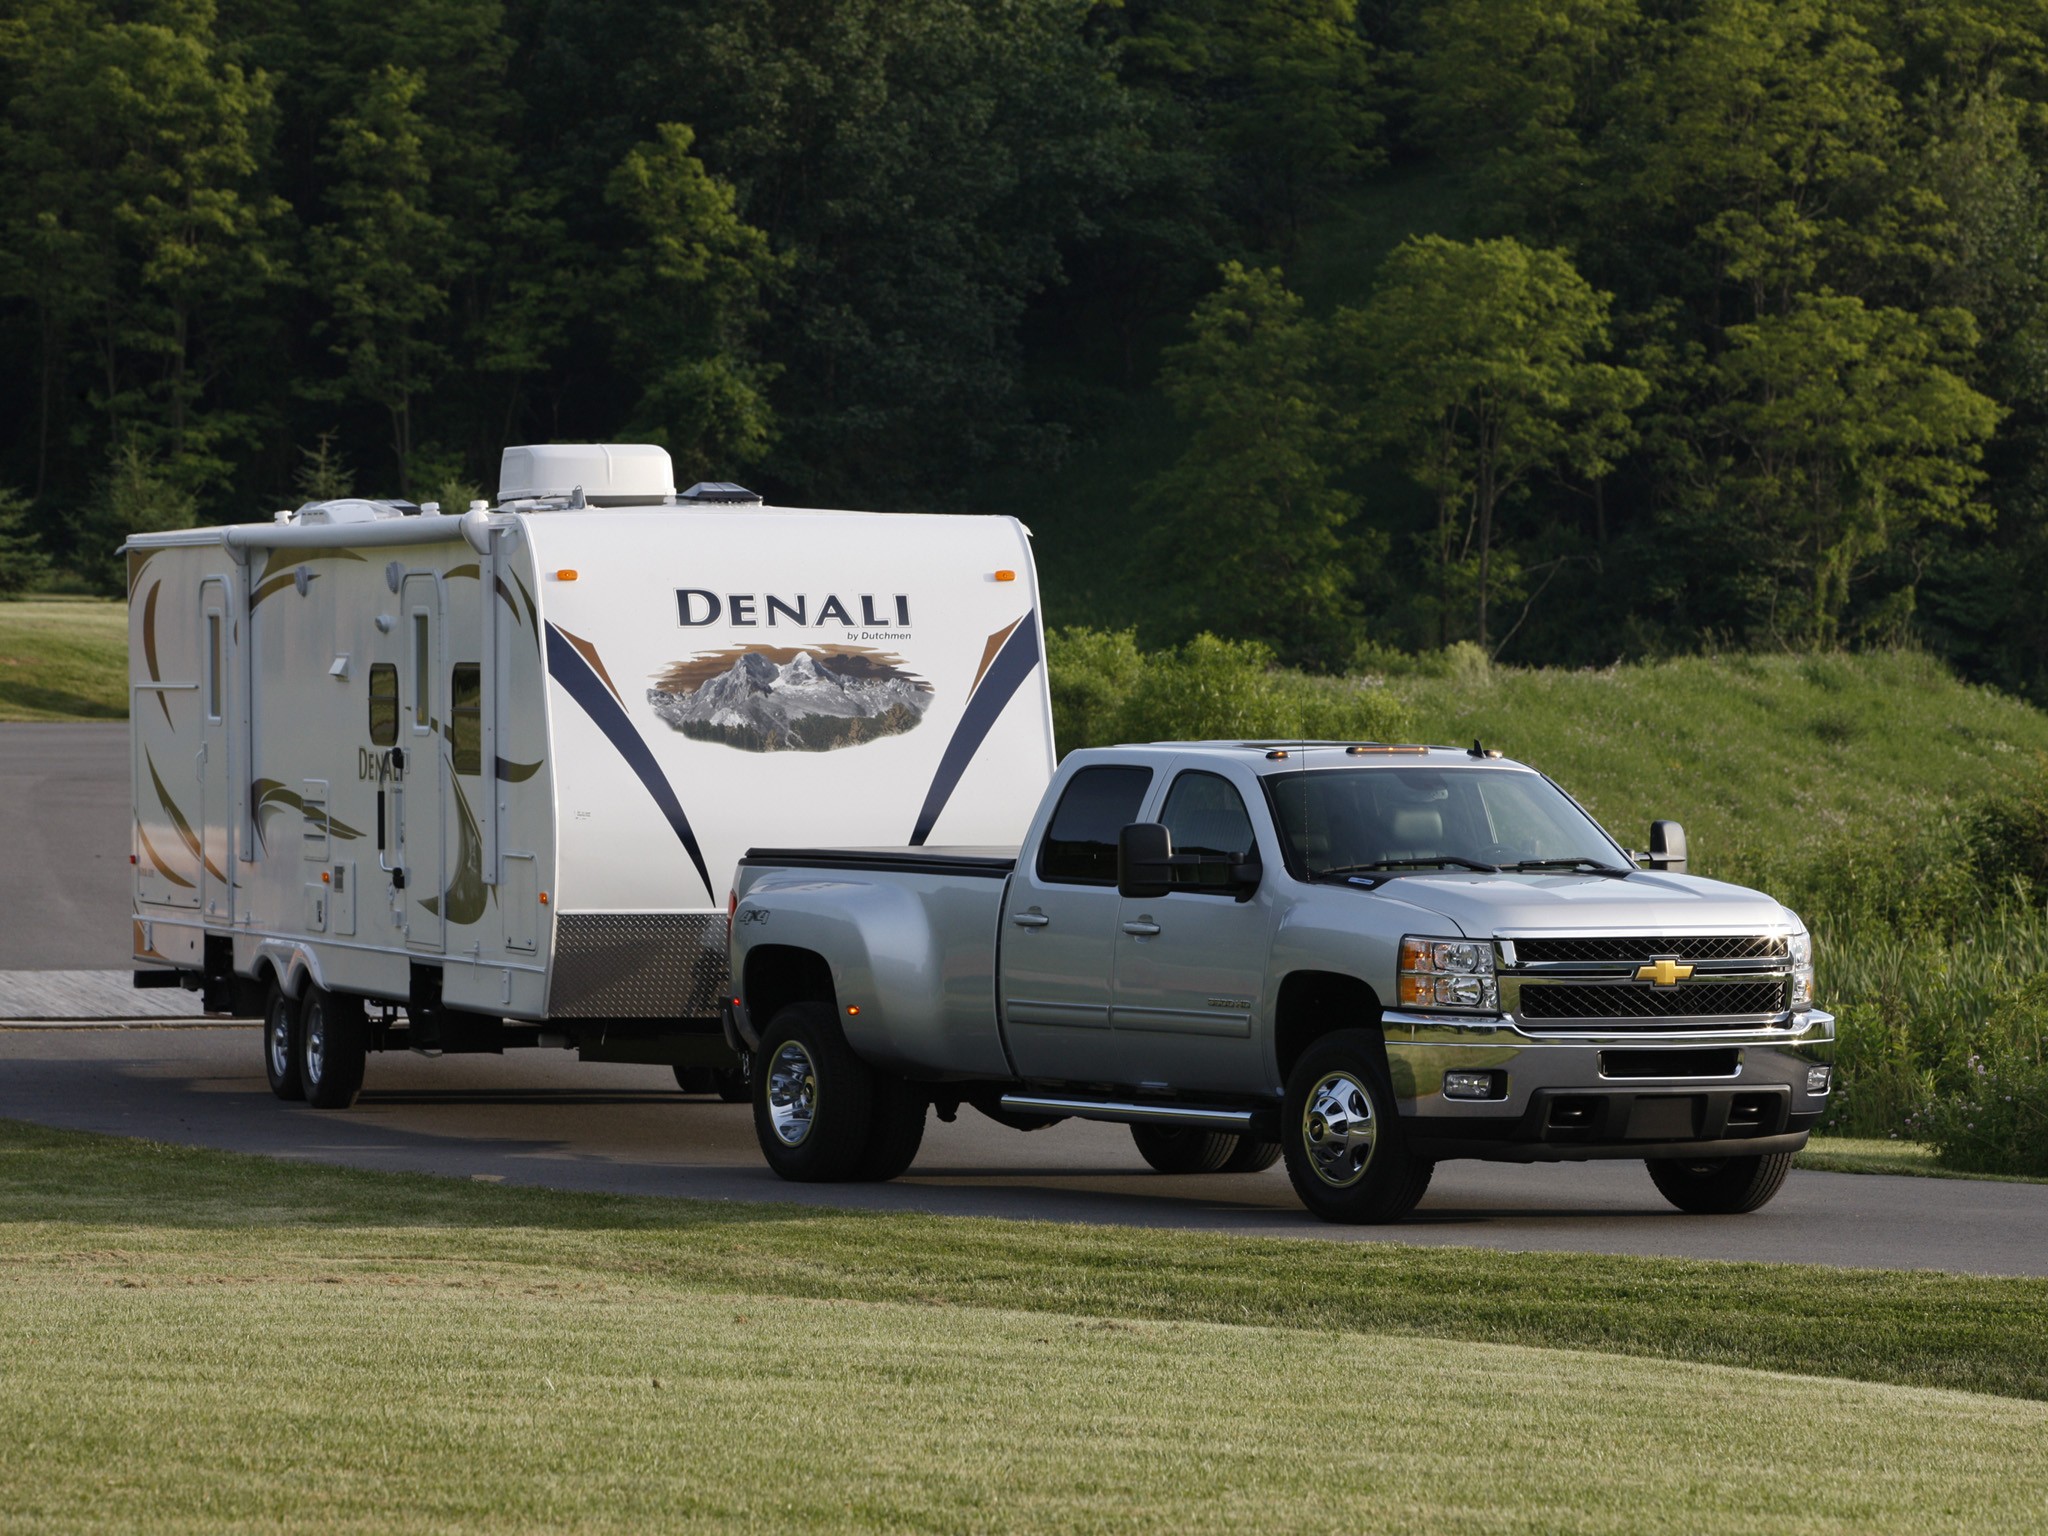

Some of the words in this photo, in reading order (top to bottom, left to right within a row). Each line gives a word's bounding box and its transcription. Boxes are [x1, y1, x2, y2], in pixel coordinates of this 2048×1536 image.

[674, 588, 912, 628] DENALI
[847, 631, 859, 641] by
[861, 631, 912, 640] Dutchmen
